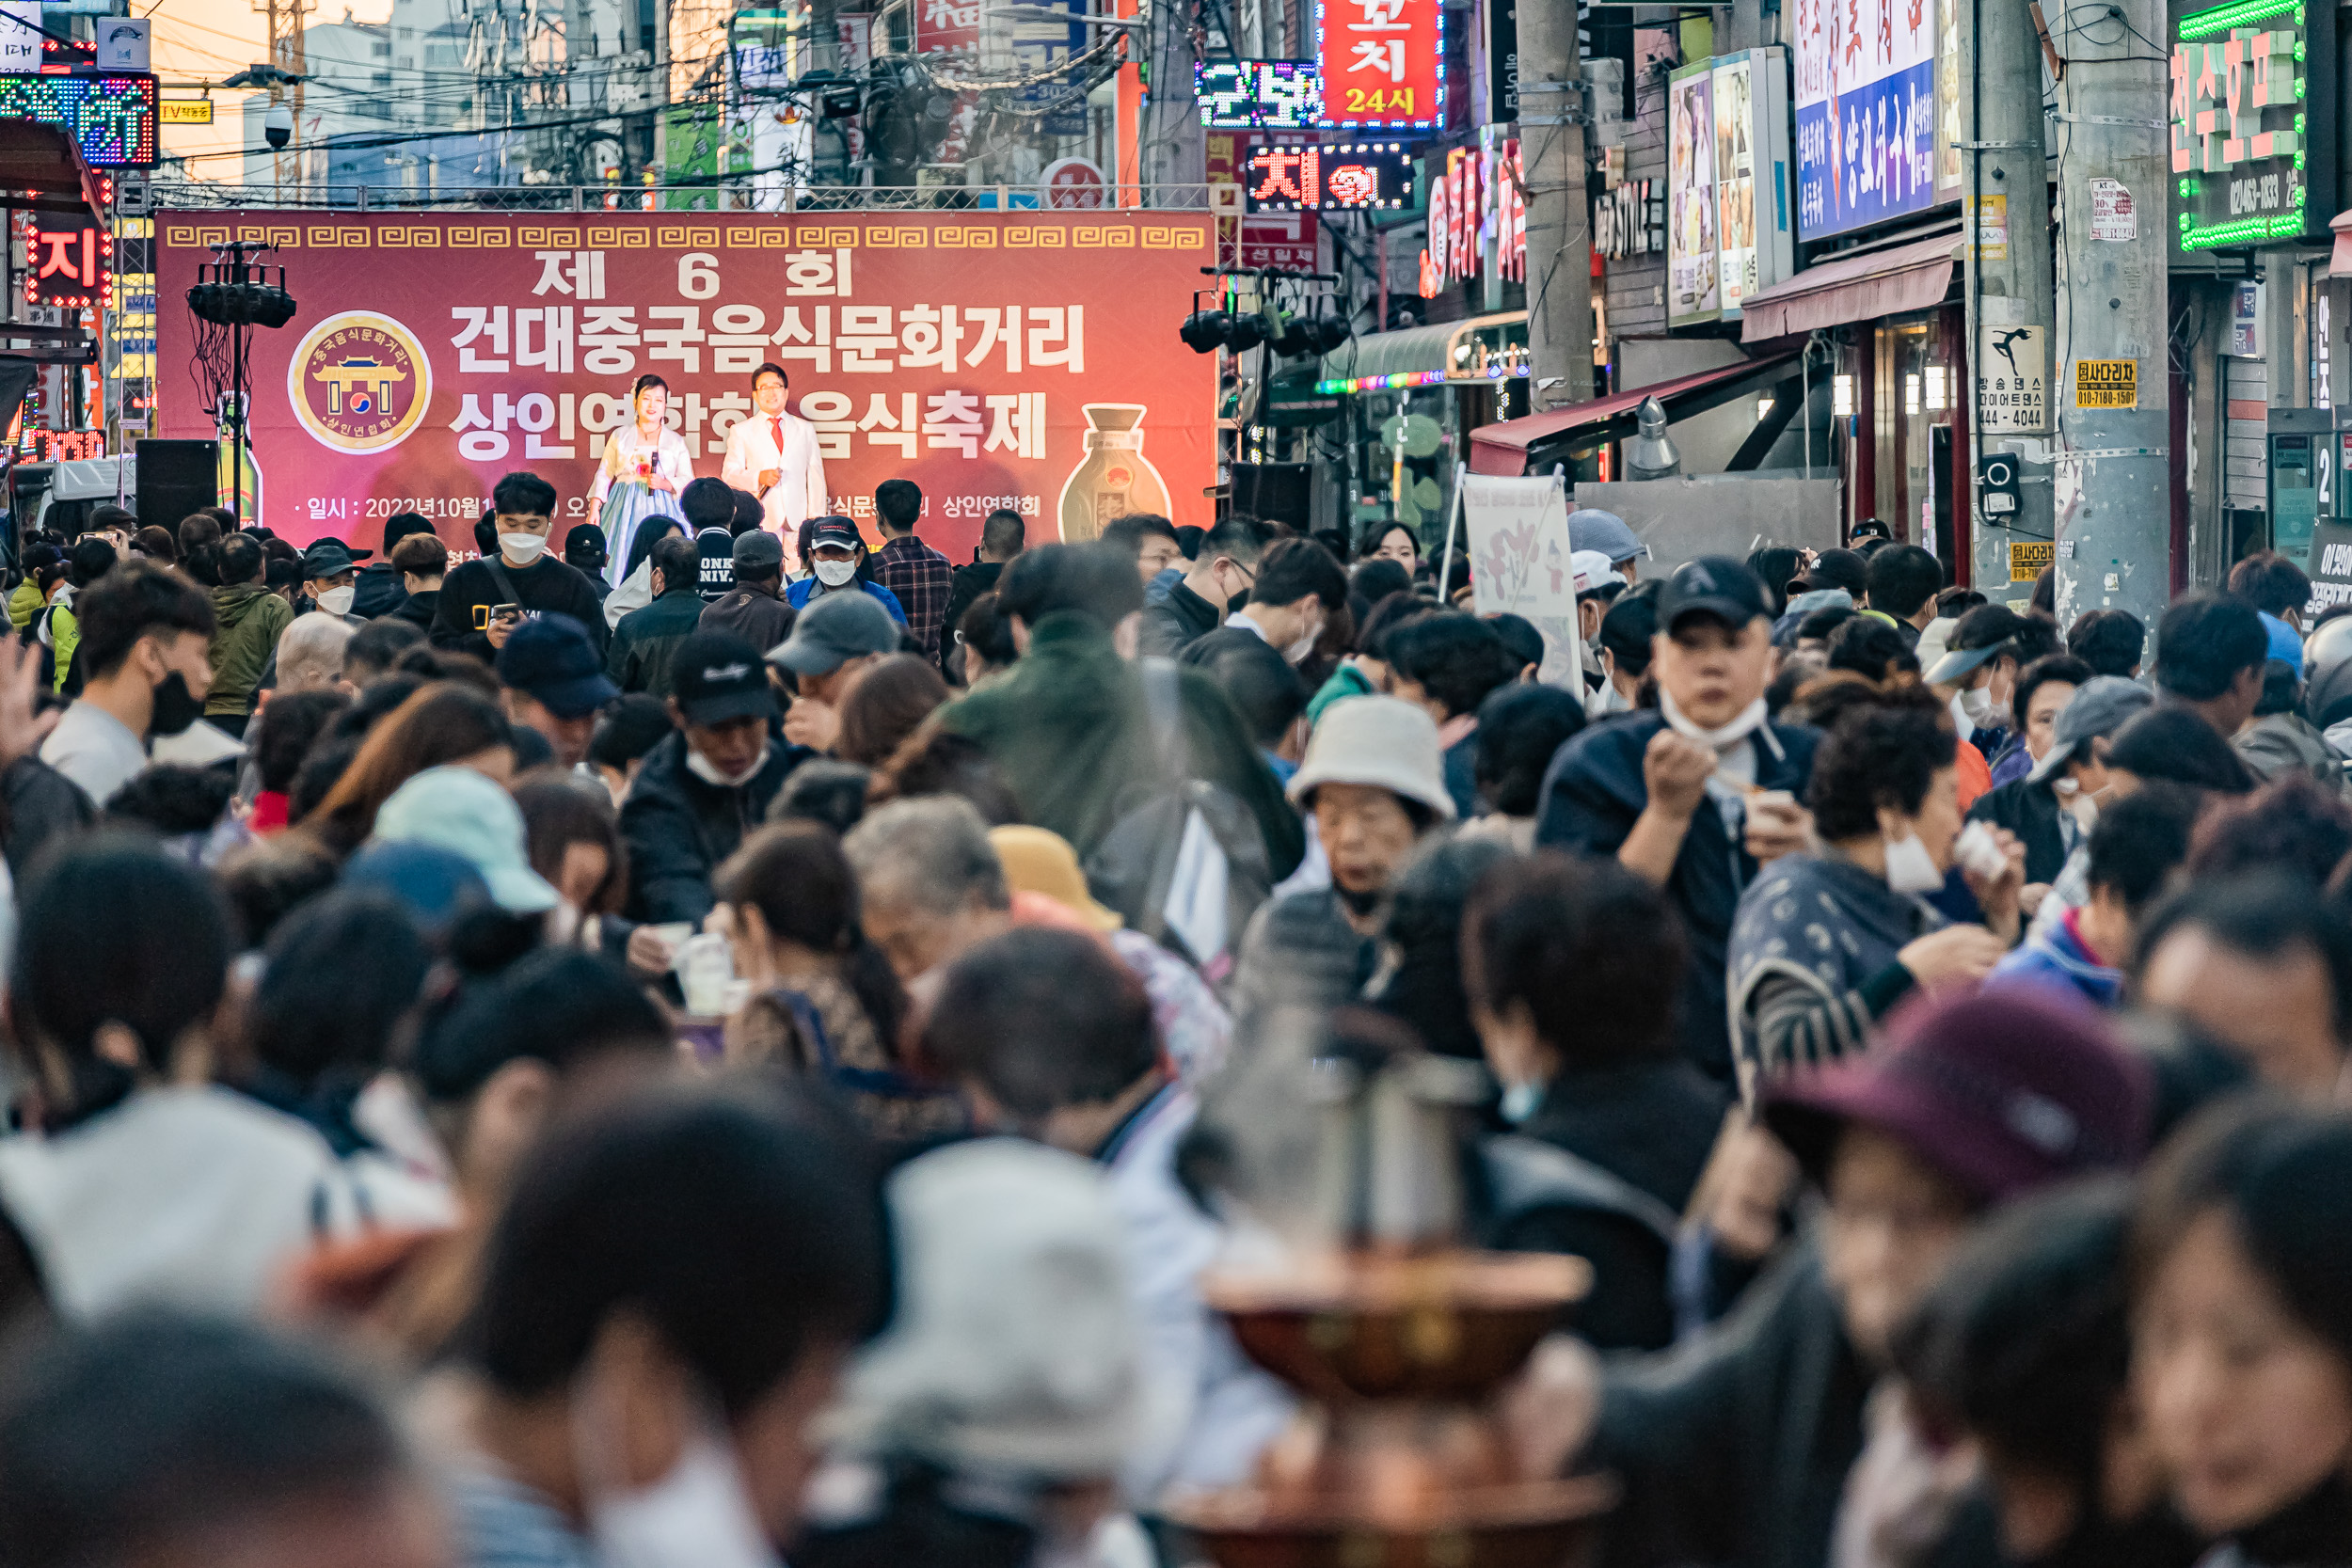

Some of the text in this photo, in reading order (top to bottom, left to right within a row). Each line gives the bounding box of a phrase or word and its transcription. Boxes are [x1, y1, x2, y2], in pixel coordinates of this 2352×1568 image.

[1345, 87, 1415, 116] 24시
[532, 248, 851, 299] 제 6 회
[313, 328, 408, 363] 중국음식문화거리
[450, 304, 1084, 374] 건대중국음식문화거리
[2090, 363, 2134, 381] 사다리차
[800, 390, 1046, 460] 음식축제
[308, 498, 346, 519] 일시
